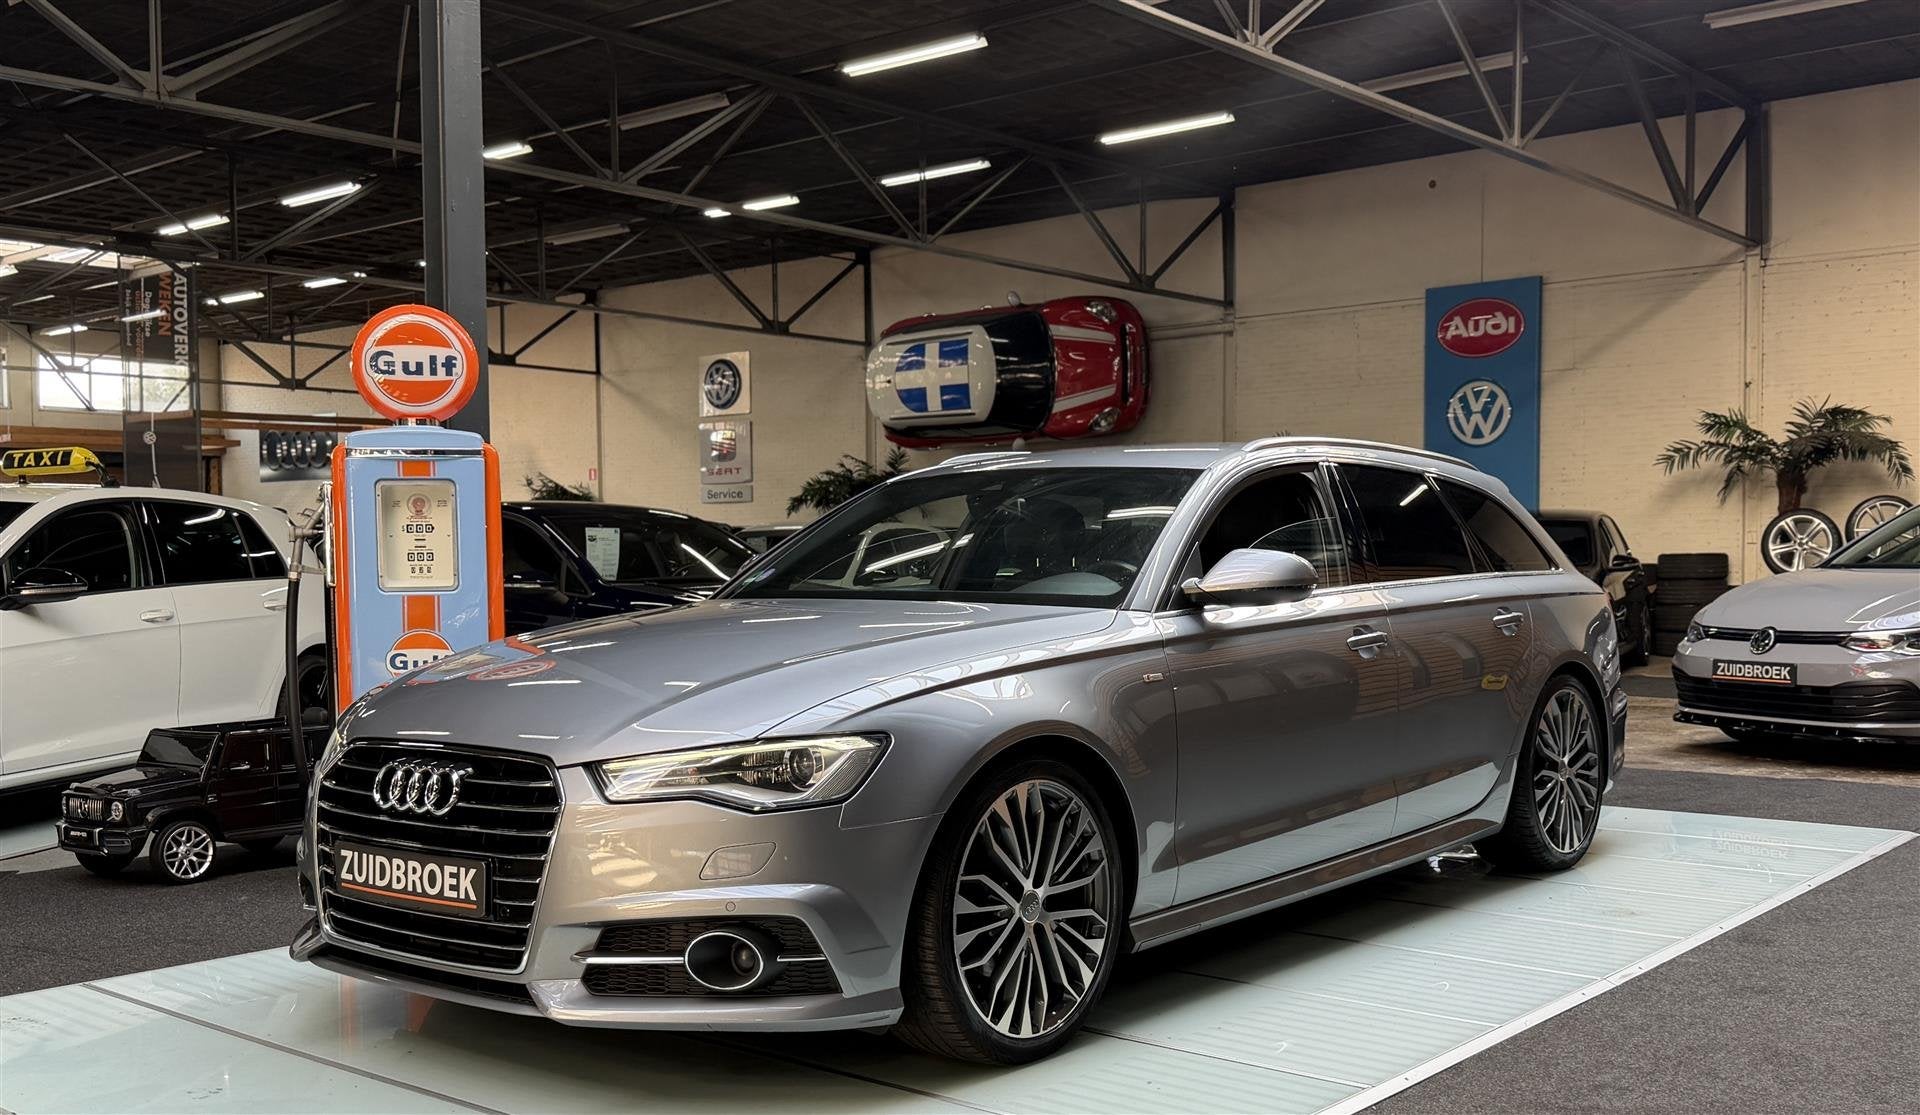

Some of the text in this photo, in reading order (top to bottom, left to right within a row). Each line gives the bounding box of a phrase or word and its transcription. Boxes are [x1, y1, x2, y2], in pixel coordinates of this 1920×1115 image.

[370, 350, 459, 378] Gulf
[12, 450, 64, 468] TAXI
[707, 467, 742, 476] SEAT
[707, 488, 744, 500] Service
[1716, 661, 1791, 680] ZUIDBROEK
[340, 849, 478, 902] ZUIDBROEK
